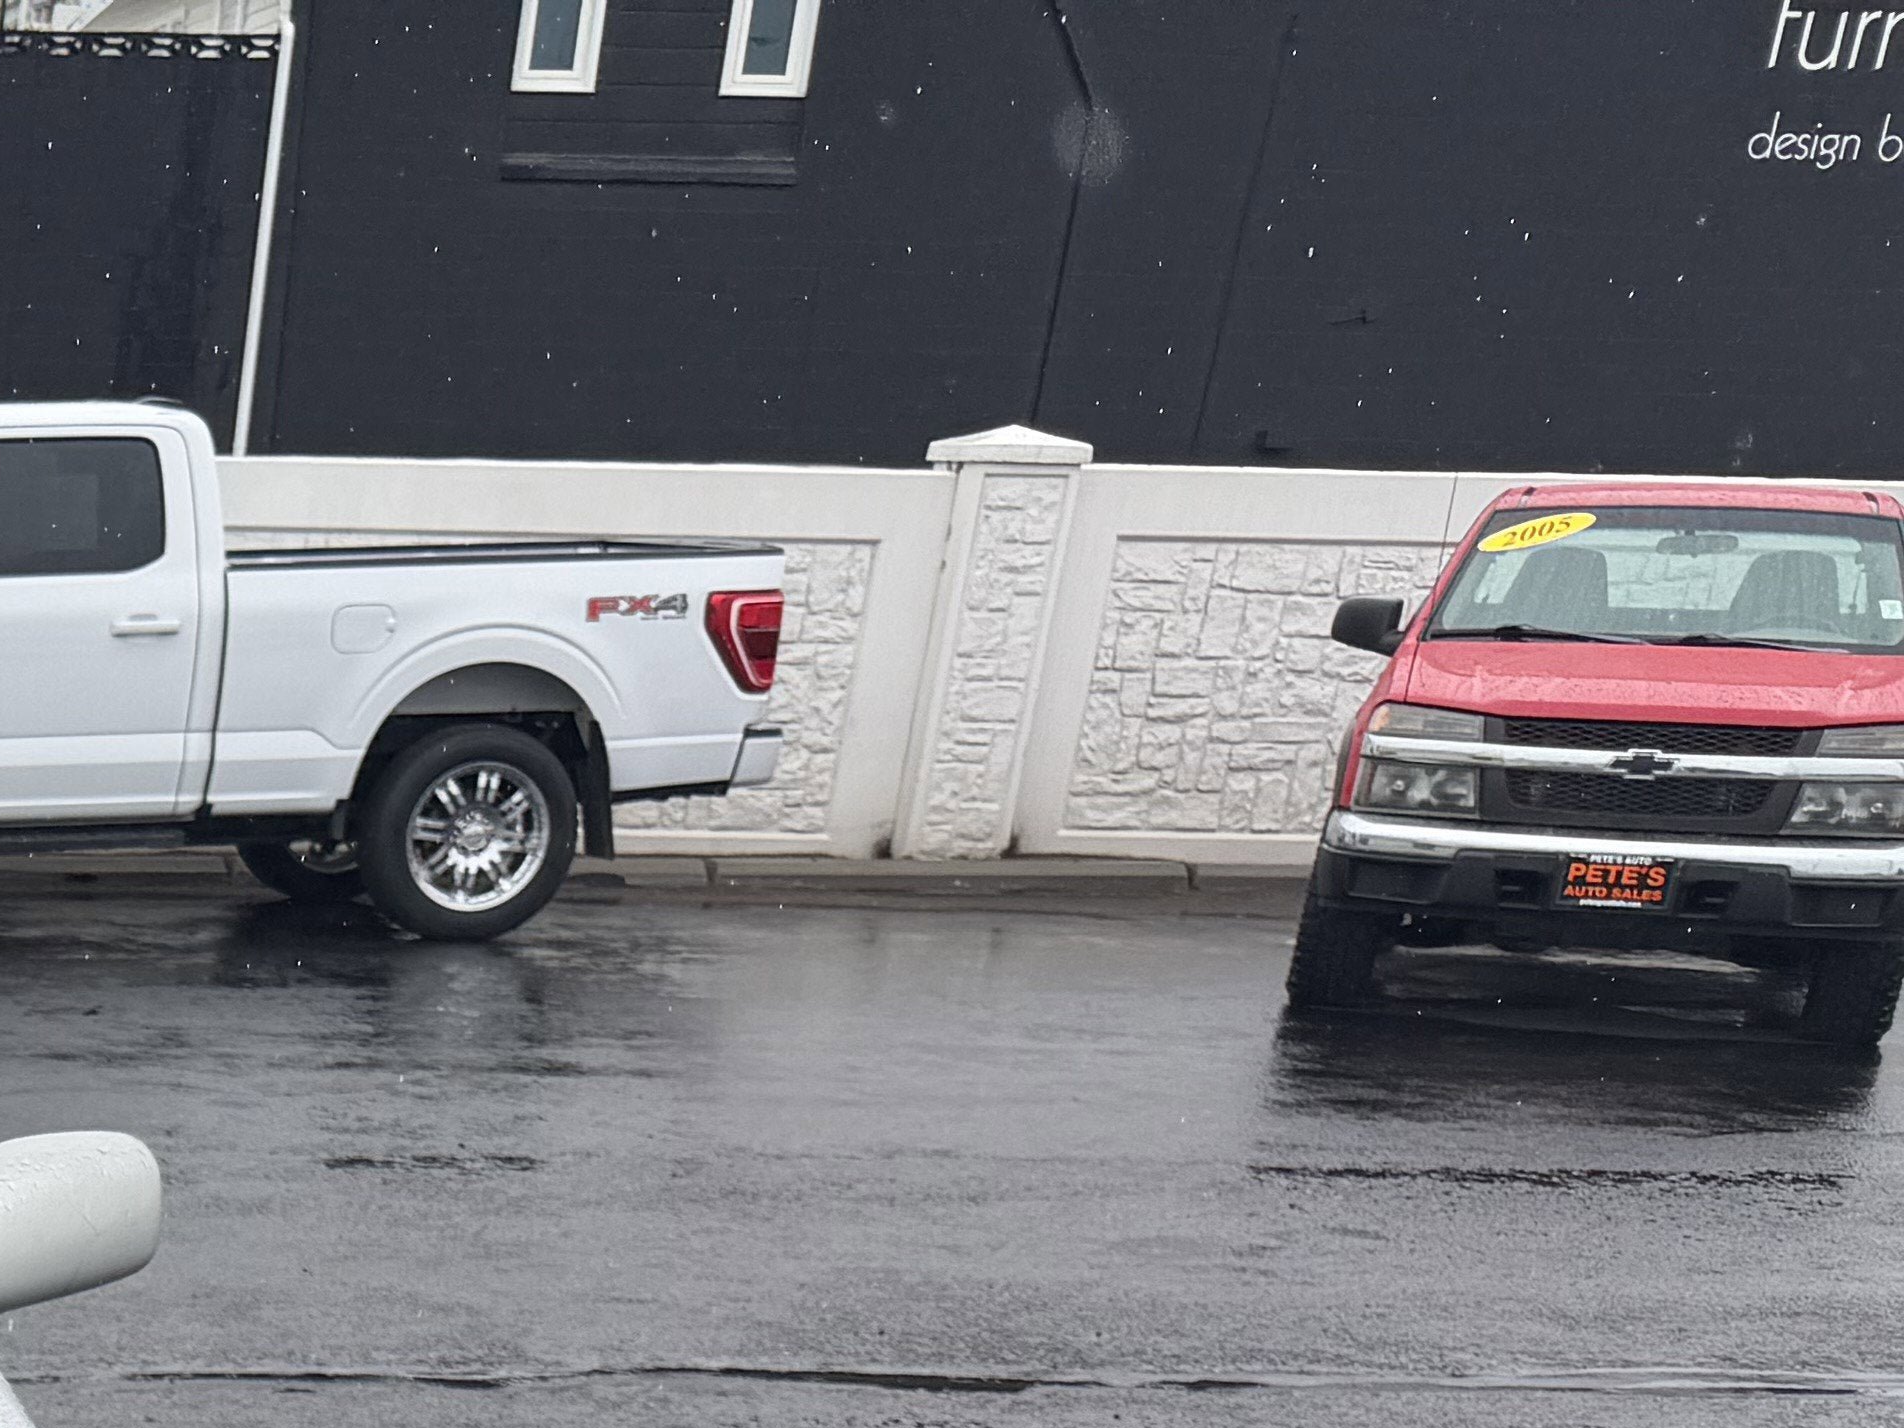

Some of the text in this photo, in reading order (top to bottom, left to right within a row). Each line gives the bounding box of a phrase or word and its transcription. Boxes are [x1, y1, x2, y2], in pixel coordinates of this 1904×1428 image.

[1747, 111, 1863, 170] design
[1503, 516, 1572, 547] 2005
[586, 594, 688, 622] FX4
[1567, 863, 1666, 887] PETE'S
[1563, 885, 1663, 901] AUTO SALES
